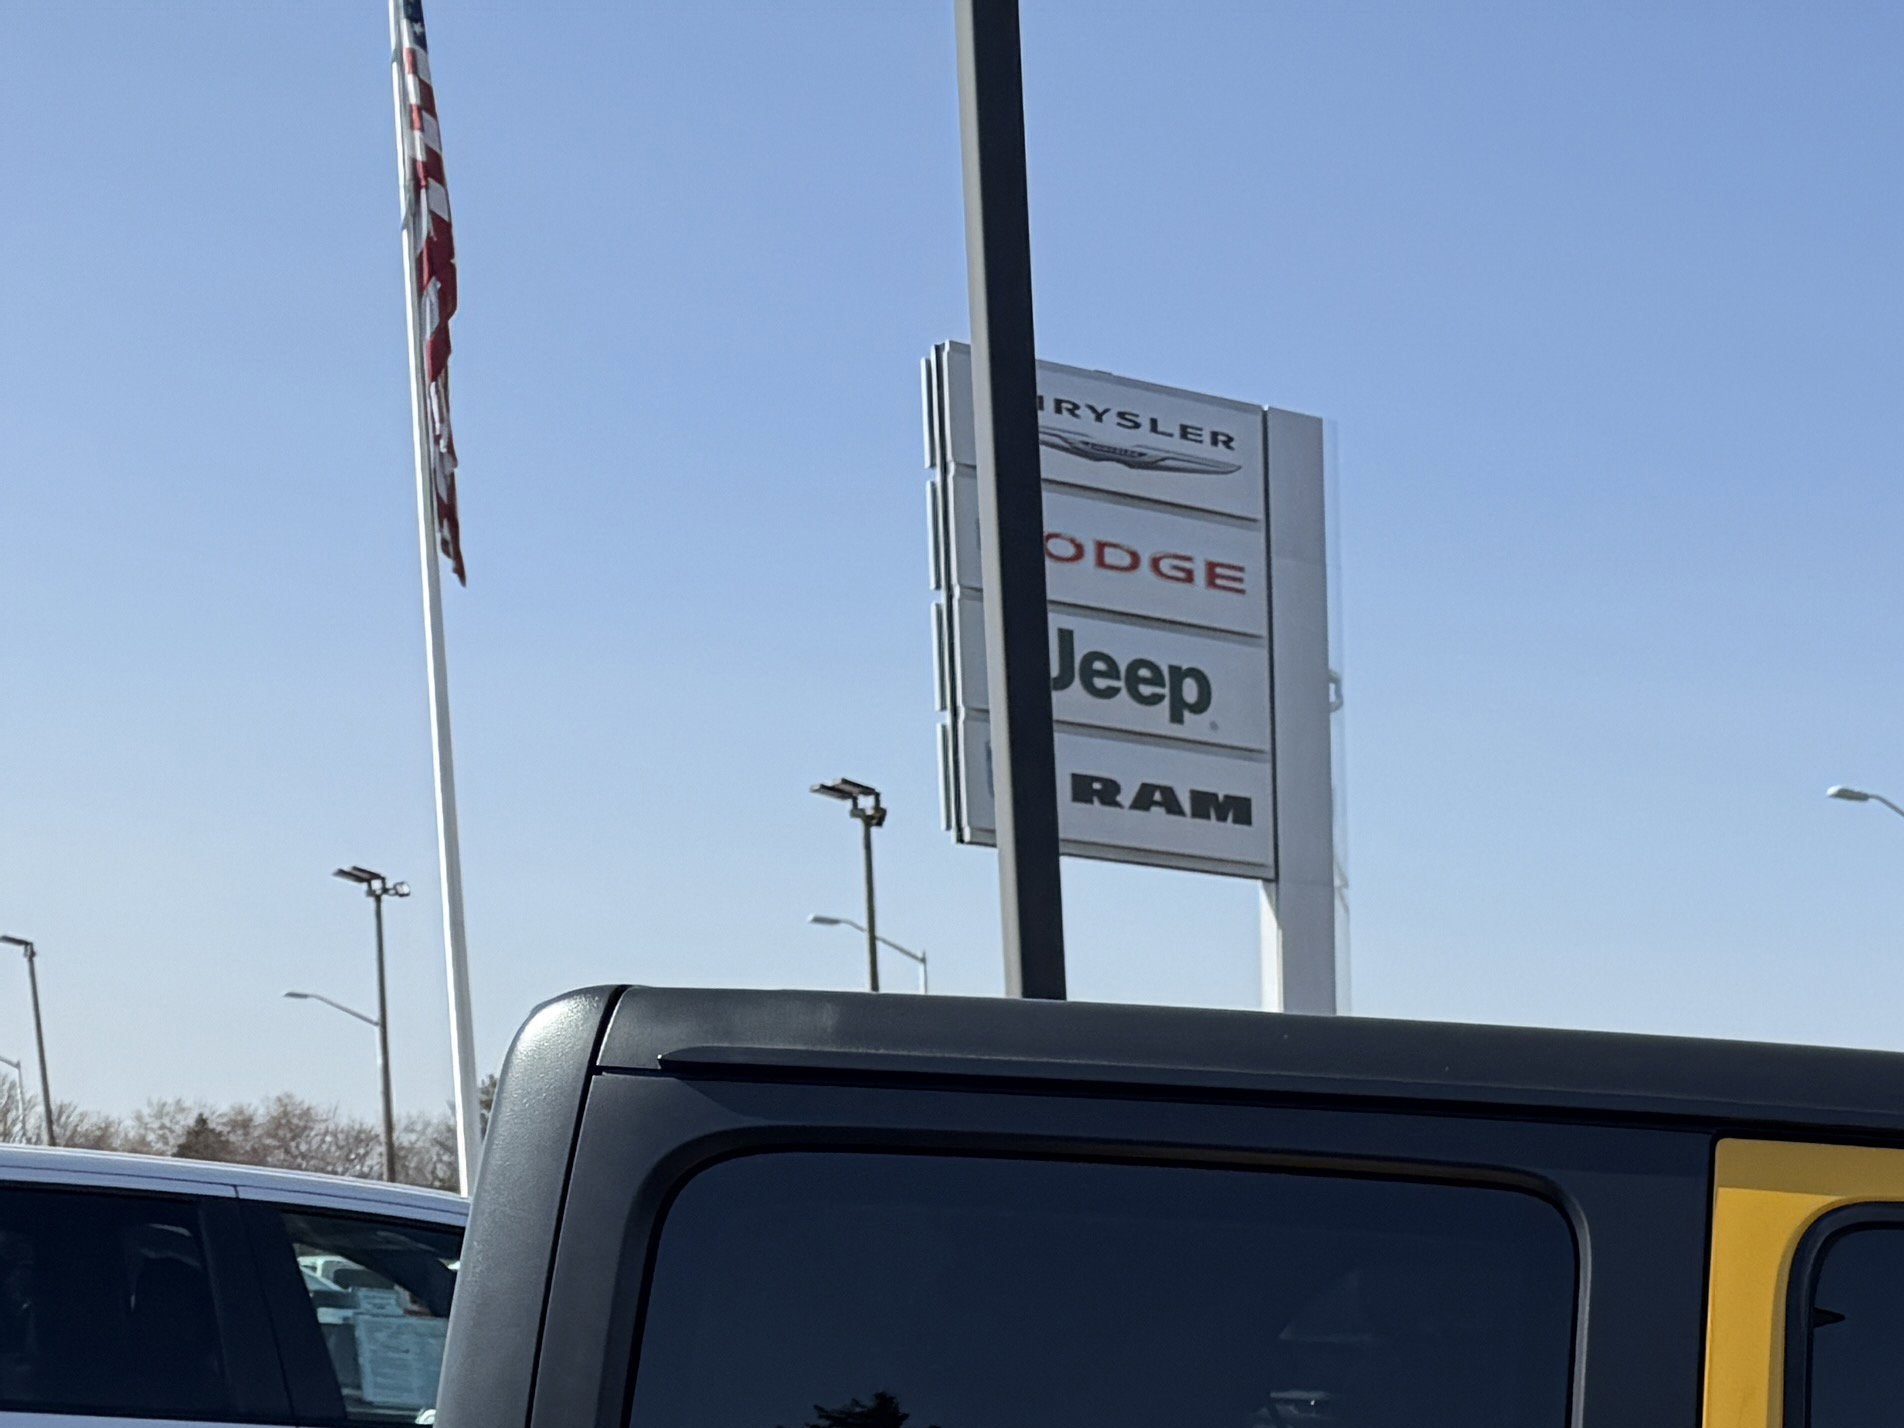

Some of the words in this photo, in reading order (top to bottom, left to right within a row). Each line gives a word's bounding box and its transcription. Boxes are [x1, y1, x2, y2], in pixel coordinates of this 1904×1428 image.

[1037, 395, 1236, 451] RYSLER
[1043, 531, 1247, 595] ODGE
[1051, 628, 1212, 724] Jeep
[1070, 772, 1253, 827] RAM
